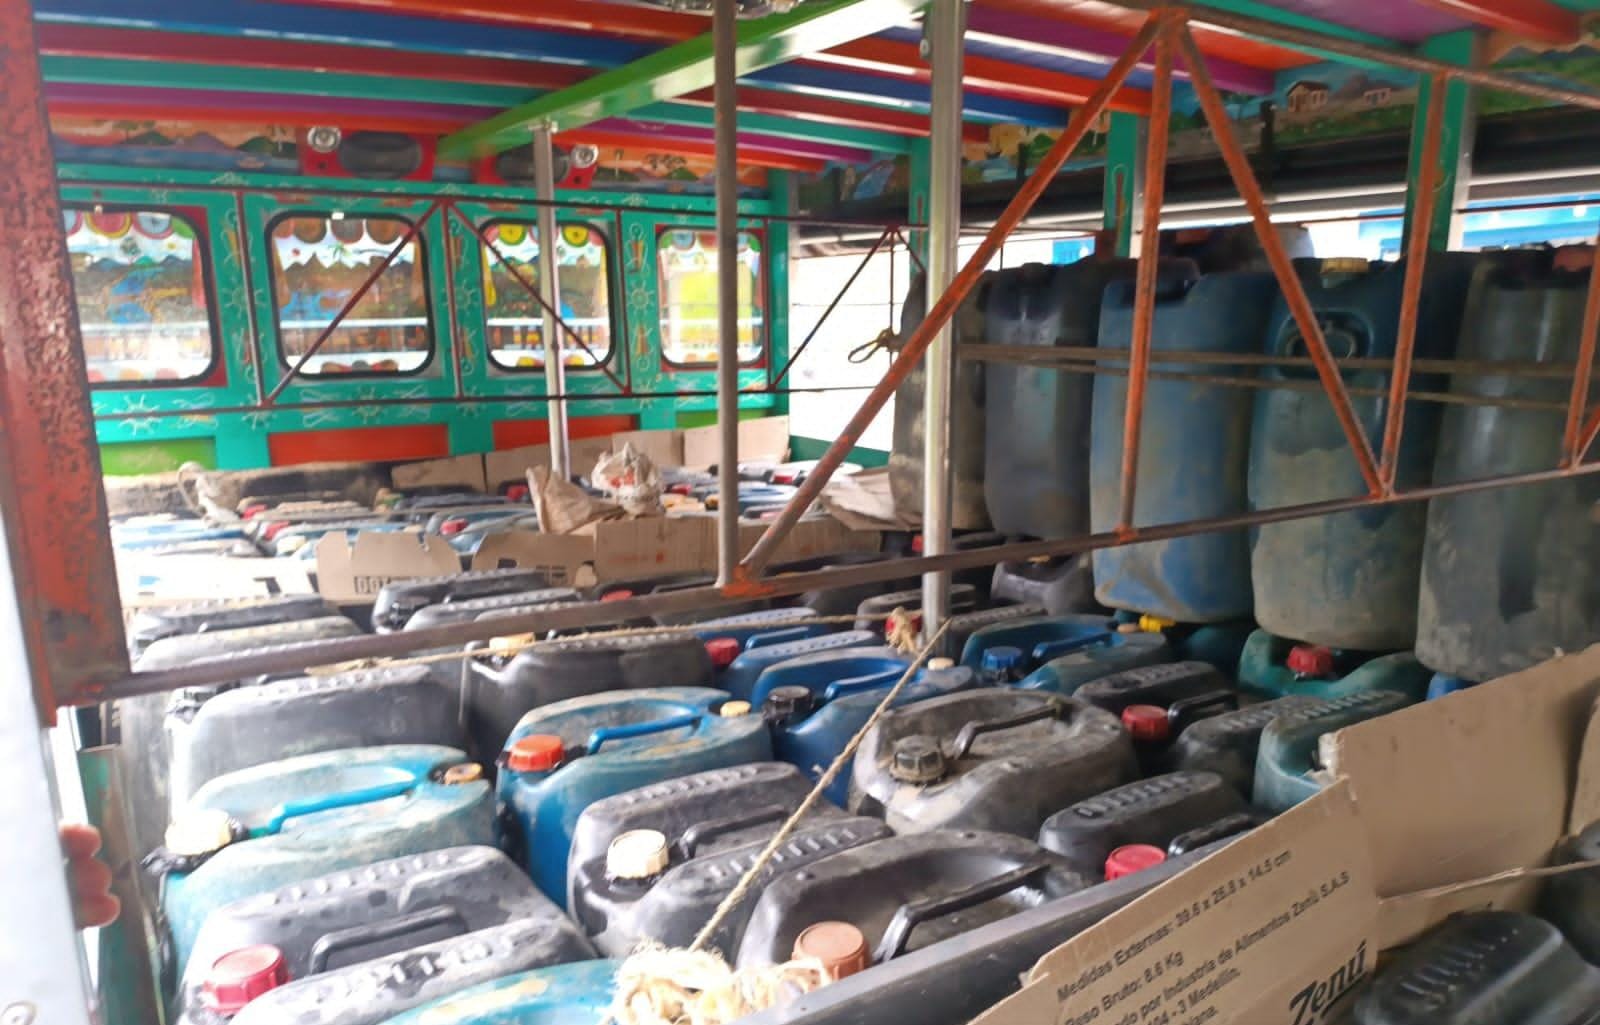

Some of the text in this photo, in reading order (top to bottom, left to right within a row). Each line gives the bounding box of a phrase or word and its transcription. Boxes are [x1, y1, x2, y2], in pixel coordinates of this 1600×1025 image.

[1057, 961, 1113, 1002] Medidas
[1114, 922, 1173, 966] Externas:
[1202, 899, 1211, 911] x
[1239, 877, 1247, 889] x
[1273, 850, 1291, 867] cm
[1140, 995, 1162, 1020] por
[1162, 960, 1217, 1002] Industria
[1217, 947, 1233, 965] de
[1235, 911, 1291, 955] Alimentos
[1291, 889, 1320, 917] Zenú
[1102, 977, 1142, 1011] Bruto:
[1164, 951, 1184, 970] Kg
[1178, 999, 1188, 1014] 3
[1289, 937, 1367, 1025] Zenú
